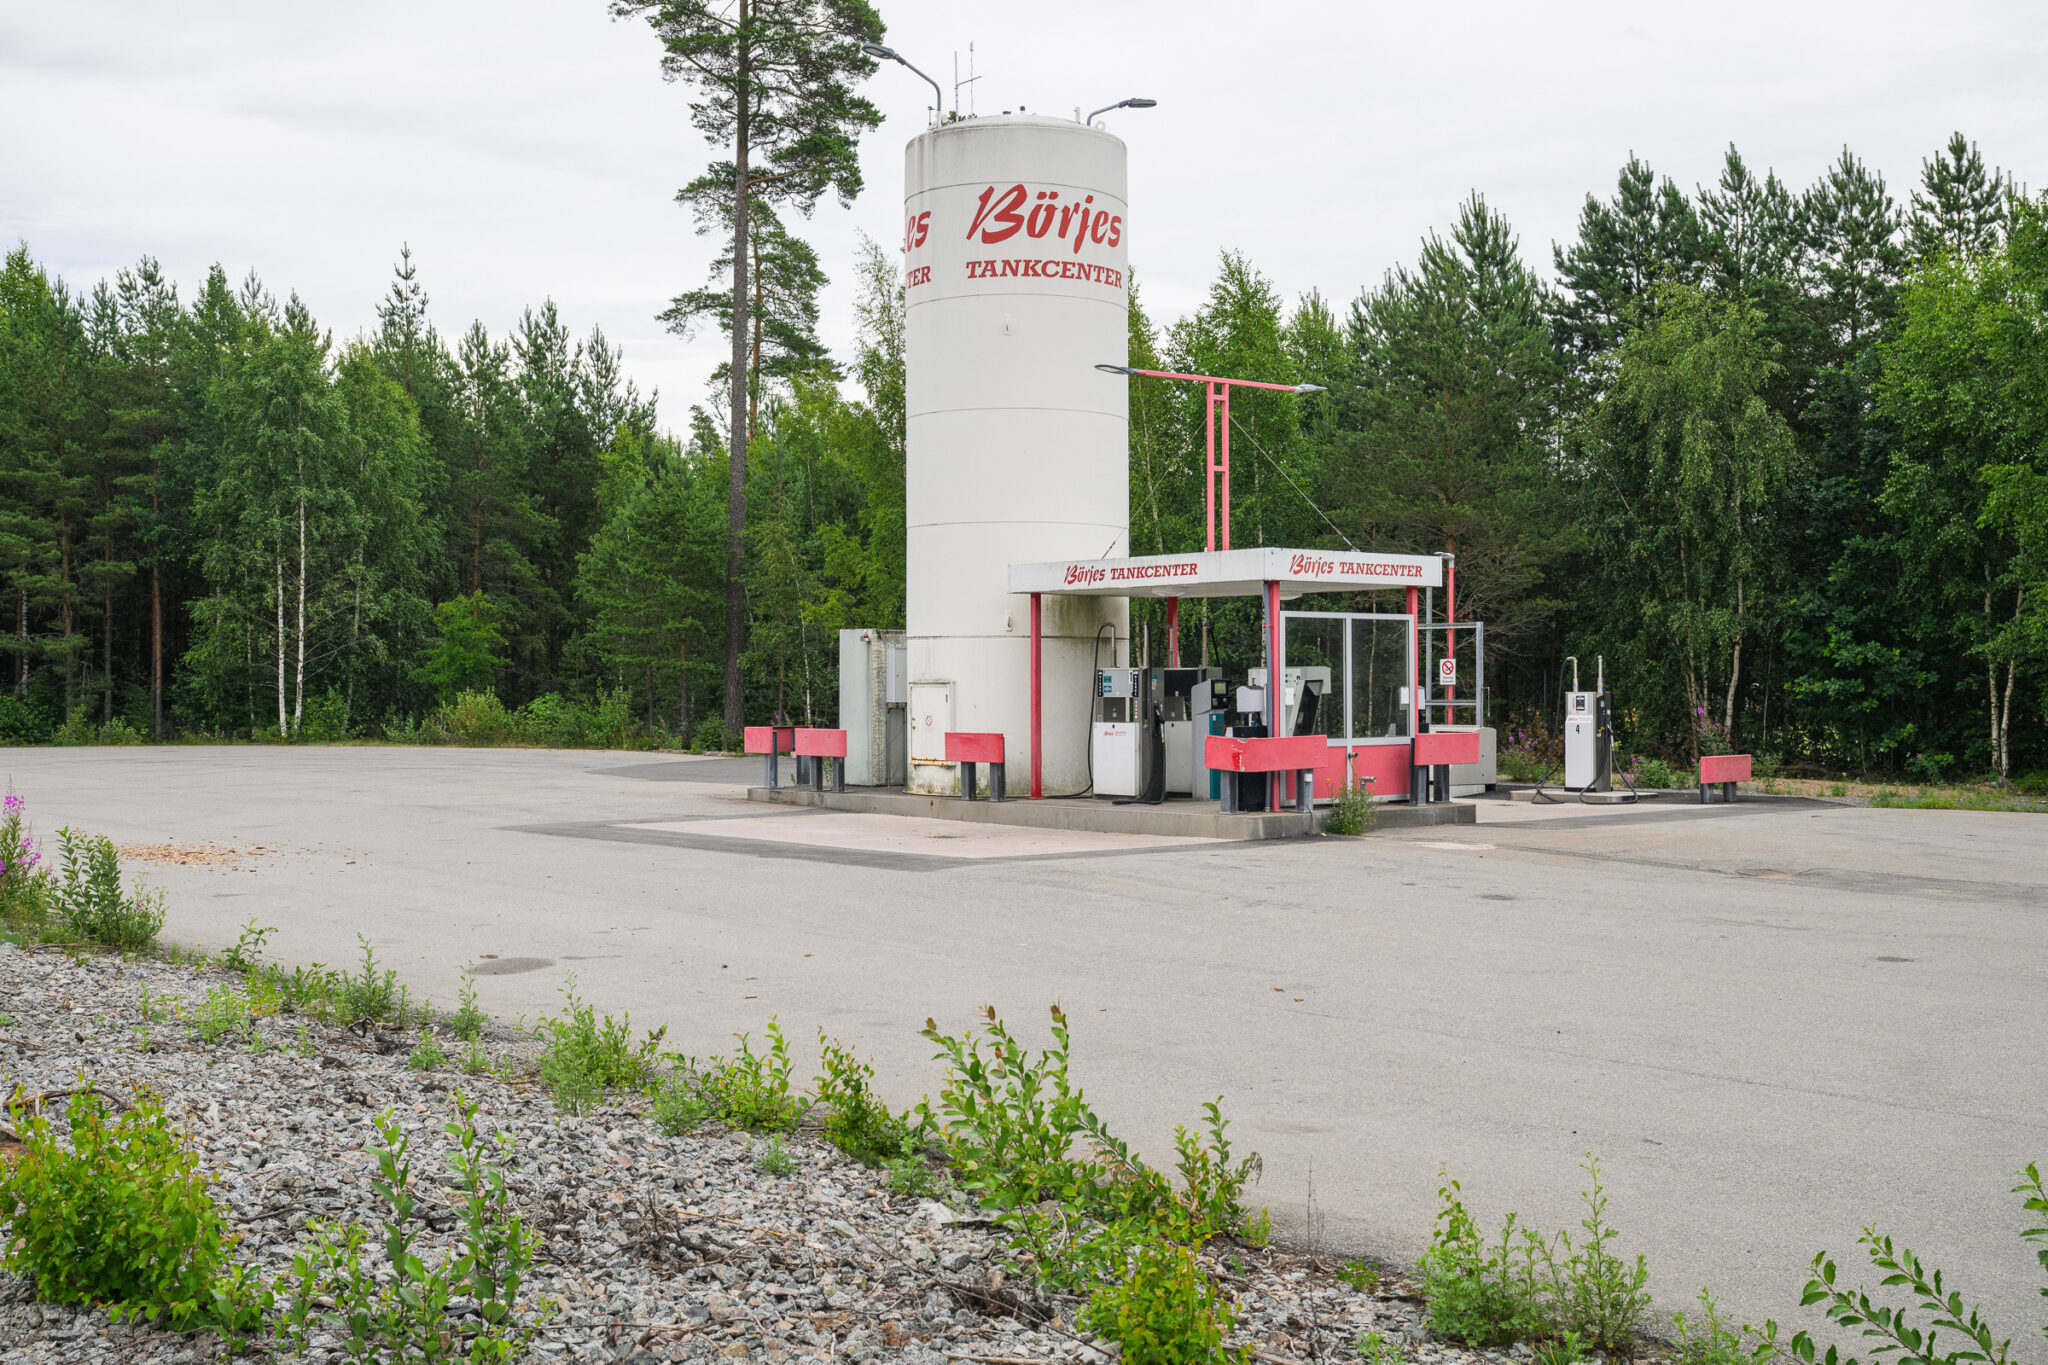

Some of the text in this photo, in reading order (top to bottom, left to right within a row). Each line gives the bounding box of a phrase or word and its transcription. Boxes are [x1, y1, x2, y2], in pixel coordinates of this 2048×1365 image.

[966, 183, 1122, 254] Börjes
[965, 259, 1122, 289] TANKCENTER
[1064, 563, 1198, 586] Börjes TANKCENTER
[1289, 553, 1423, 578] Börjes TANKCENTER
[1576, 724, 1580, 734] 4
